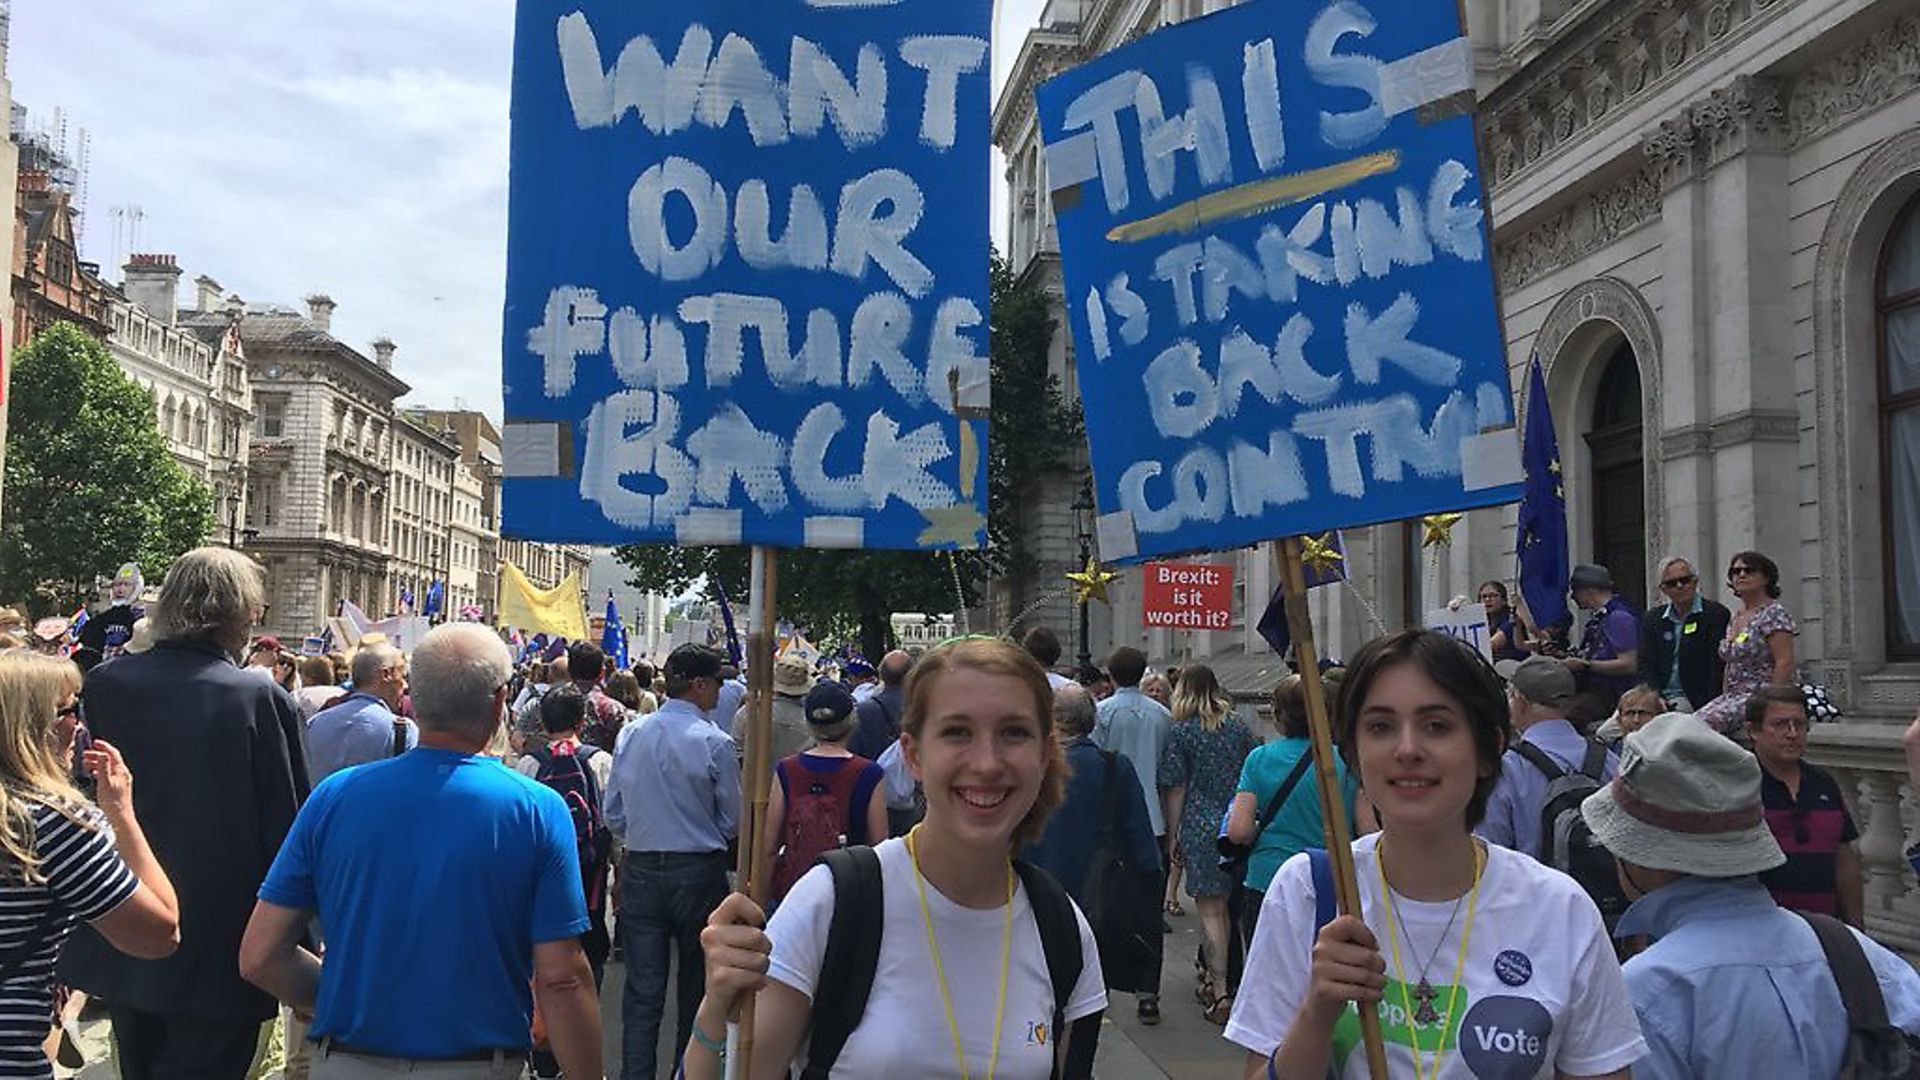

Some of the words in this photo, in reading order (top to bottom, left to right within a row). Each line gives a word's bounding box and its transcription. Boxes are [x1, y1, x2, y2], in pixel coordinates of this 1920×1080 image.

[556, 9, 988, 152] WANT
[1063, 2, 1387, 213] THIS
[628, 156, 935, 298] OUR
[1086, 271, 1150, 361] IS
[1150, 159, 1484, 326] TAKING
[1144, 290, 1462, 437] BACK
[1147, 609, 1200, 626] worth
[1206, 610, 1229, 627] it?
[1159, 567, 1220, 585] Brexit:
[1174, 588, 1187, 604] is
[1190, 589, 1203, 606] it
[1433, 622, 1486, 650] XIT
[1474, 1025, 1540, 1056] Vote
